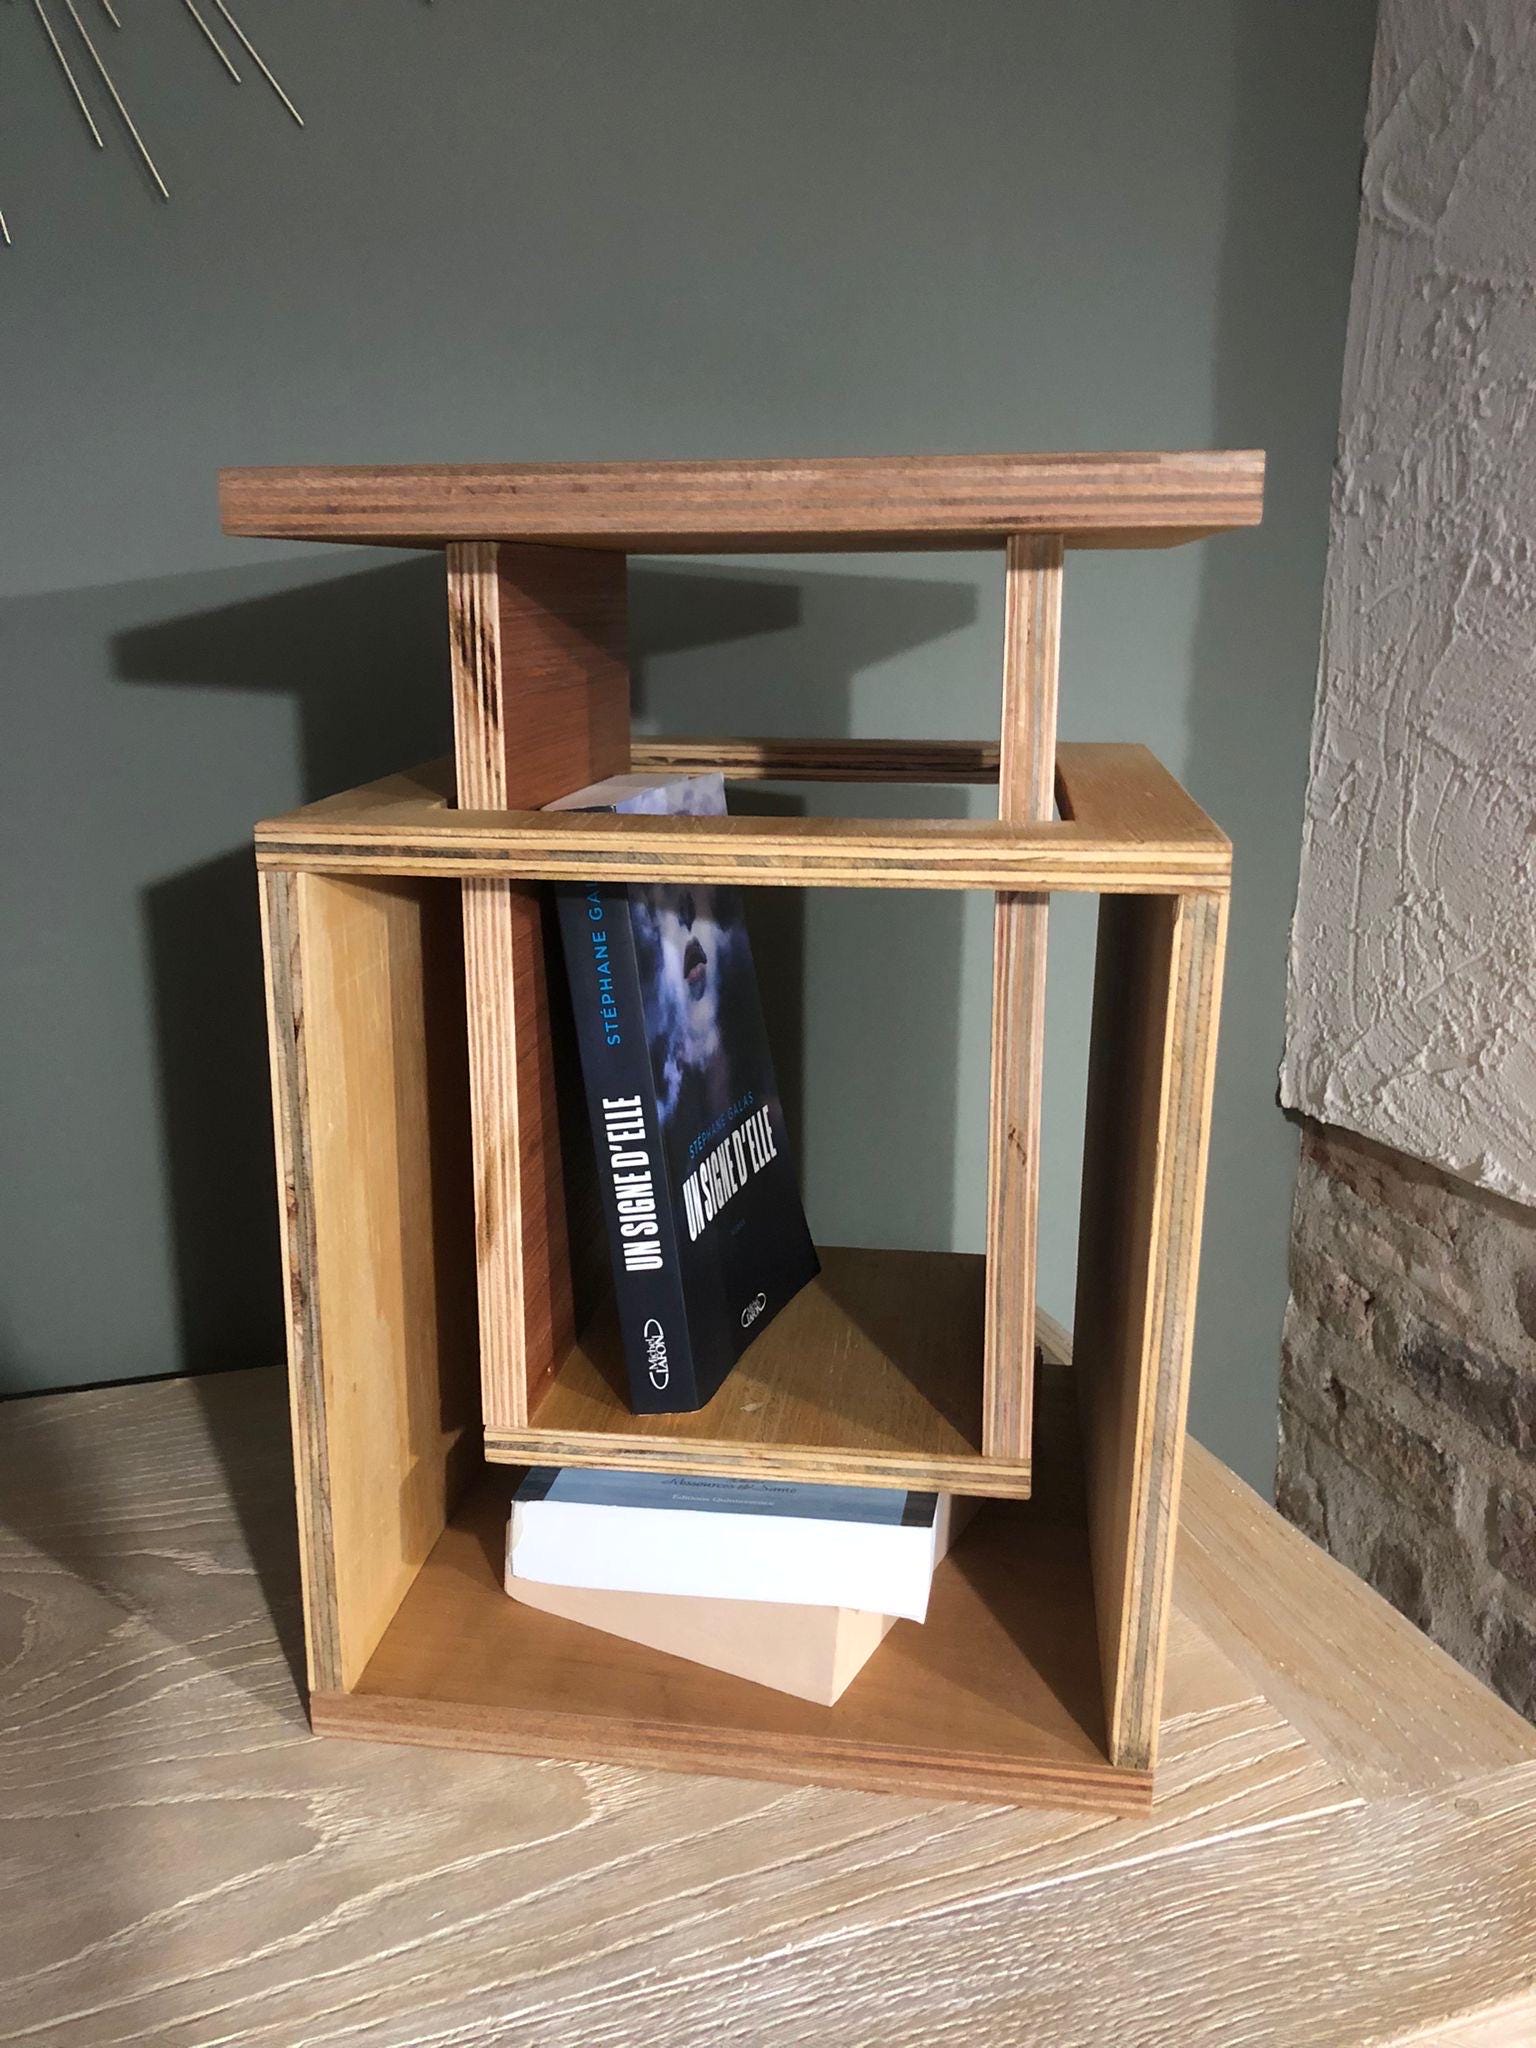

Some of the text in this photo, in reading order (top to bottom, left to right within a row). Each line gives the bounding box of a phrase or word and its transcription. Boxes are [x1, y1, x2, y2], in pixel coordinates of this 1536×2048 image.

[592, 930, 621, 1046] STÉPHANE
[602, 1094, 664, 1272] UN SIGNE D'ELLE
[682, 1104, 778, 1242] UN SIGNE D'ELLE
